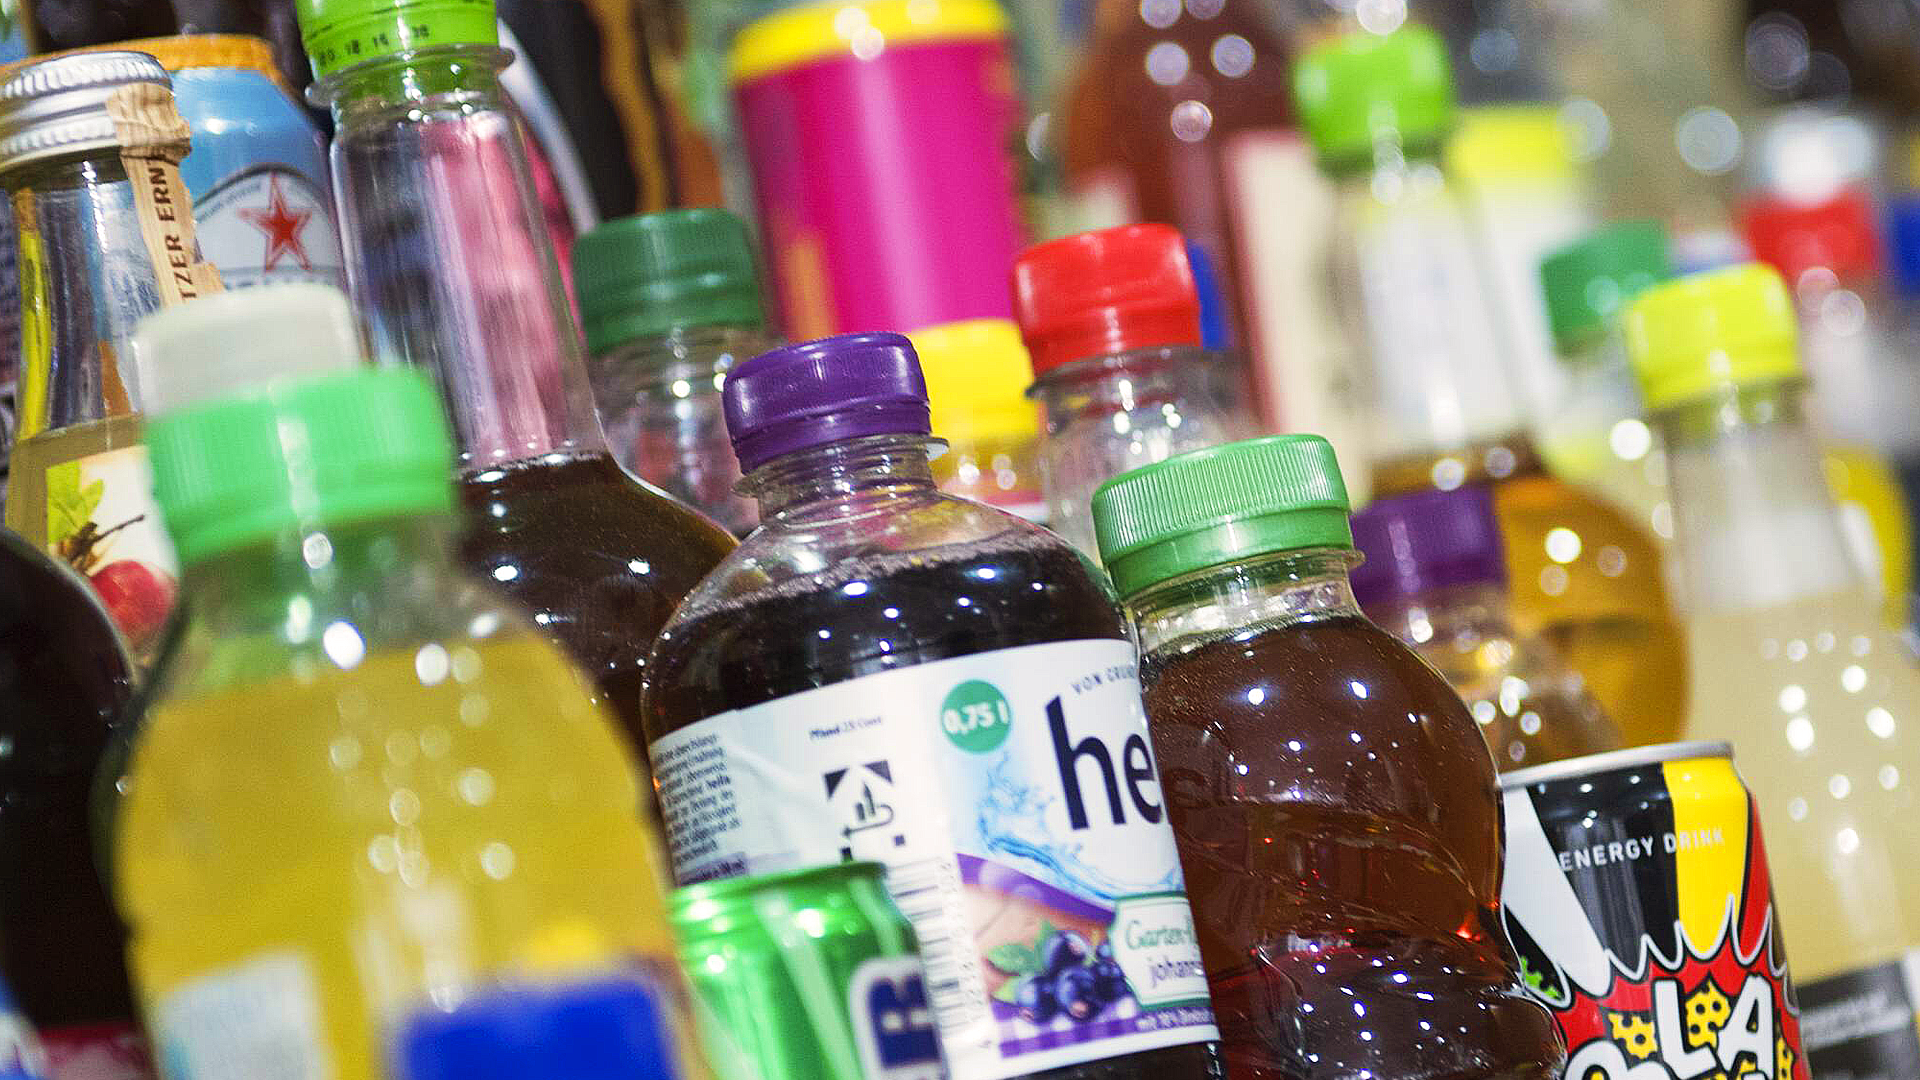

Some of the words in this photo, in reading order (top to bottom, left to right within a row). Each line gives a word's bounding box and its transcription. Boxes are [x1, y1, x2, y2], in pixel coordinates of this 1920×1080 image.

[942, 701, 997, 736] 0,75
[1558, 836, 1654, 872] ENERGY
[1663, 826, 1726, 854] DRINK
